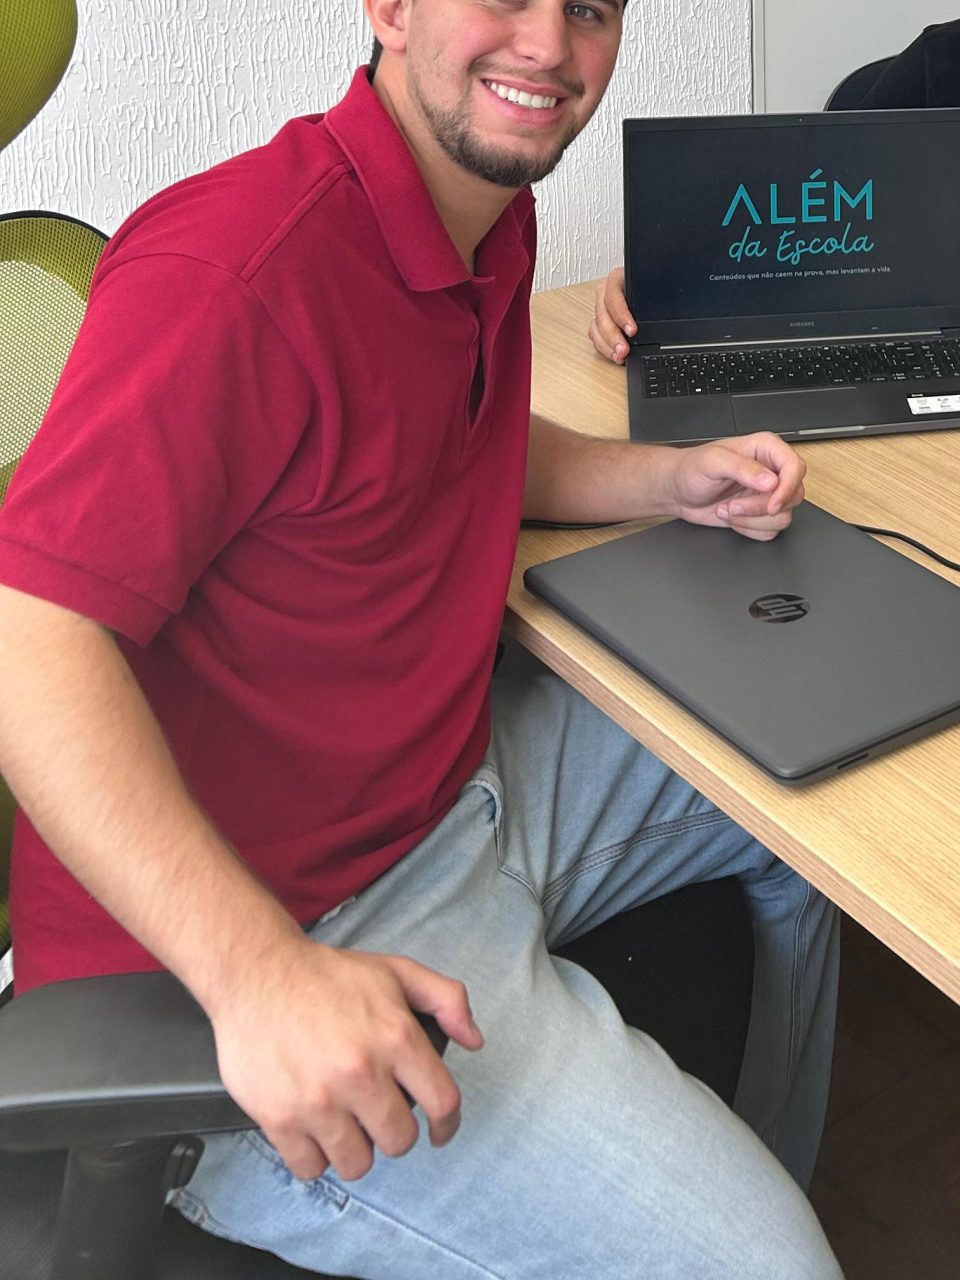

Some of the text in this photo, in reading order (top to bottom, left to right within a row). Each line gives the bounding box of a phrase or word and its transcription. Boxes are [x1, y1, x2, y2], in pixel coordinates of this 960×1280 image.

[722, 168, 873, 226] ALÉM
[728, 222, 875, 265] da Escola
[709, 273, 746, 281] Conteúdos
